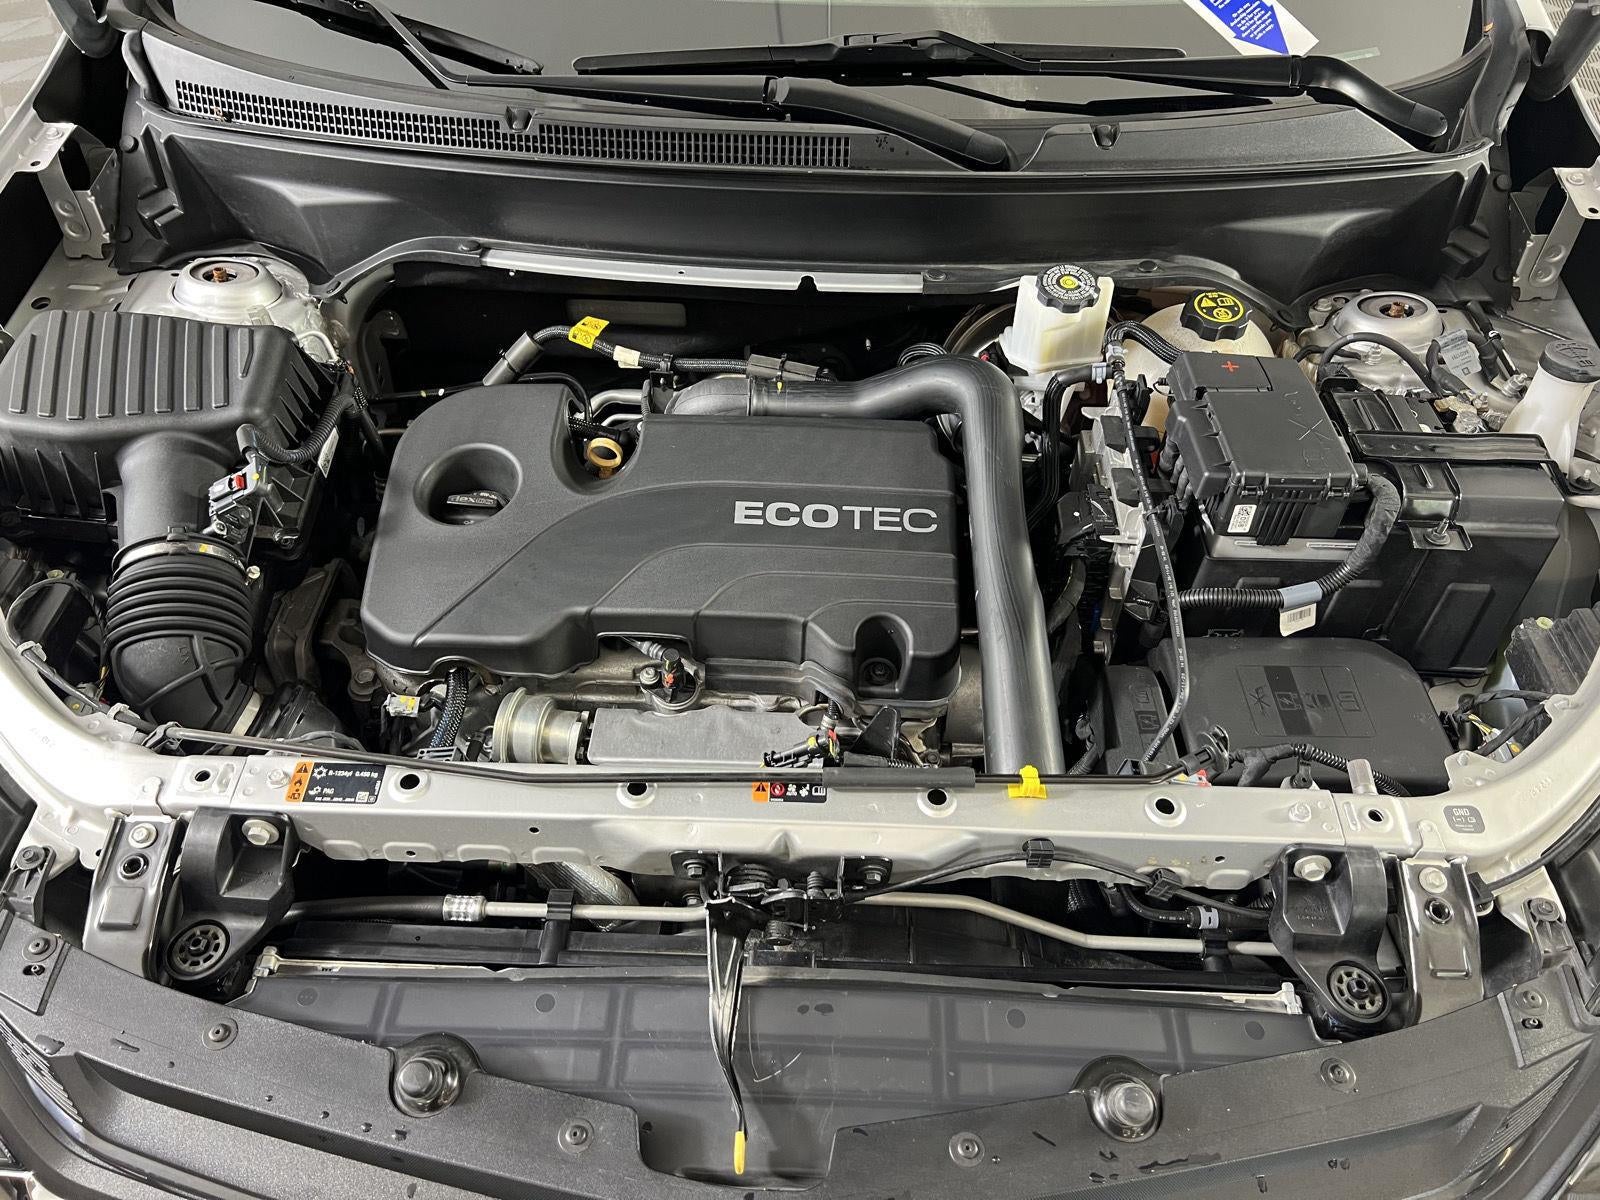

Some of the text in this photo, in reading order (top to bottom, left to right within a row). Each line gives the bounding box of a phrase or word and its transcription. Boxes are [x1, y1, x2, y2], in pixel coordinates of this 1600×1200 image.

[733, 500, 938, 533] ECOTEC
[322, 787, 335, 795] PAG
[1452, 808, 1470, 816] GND
